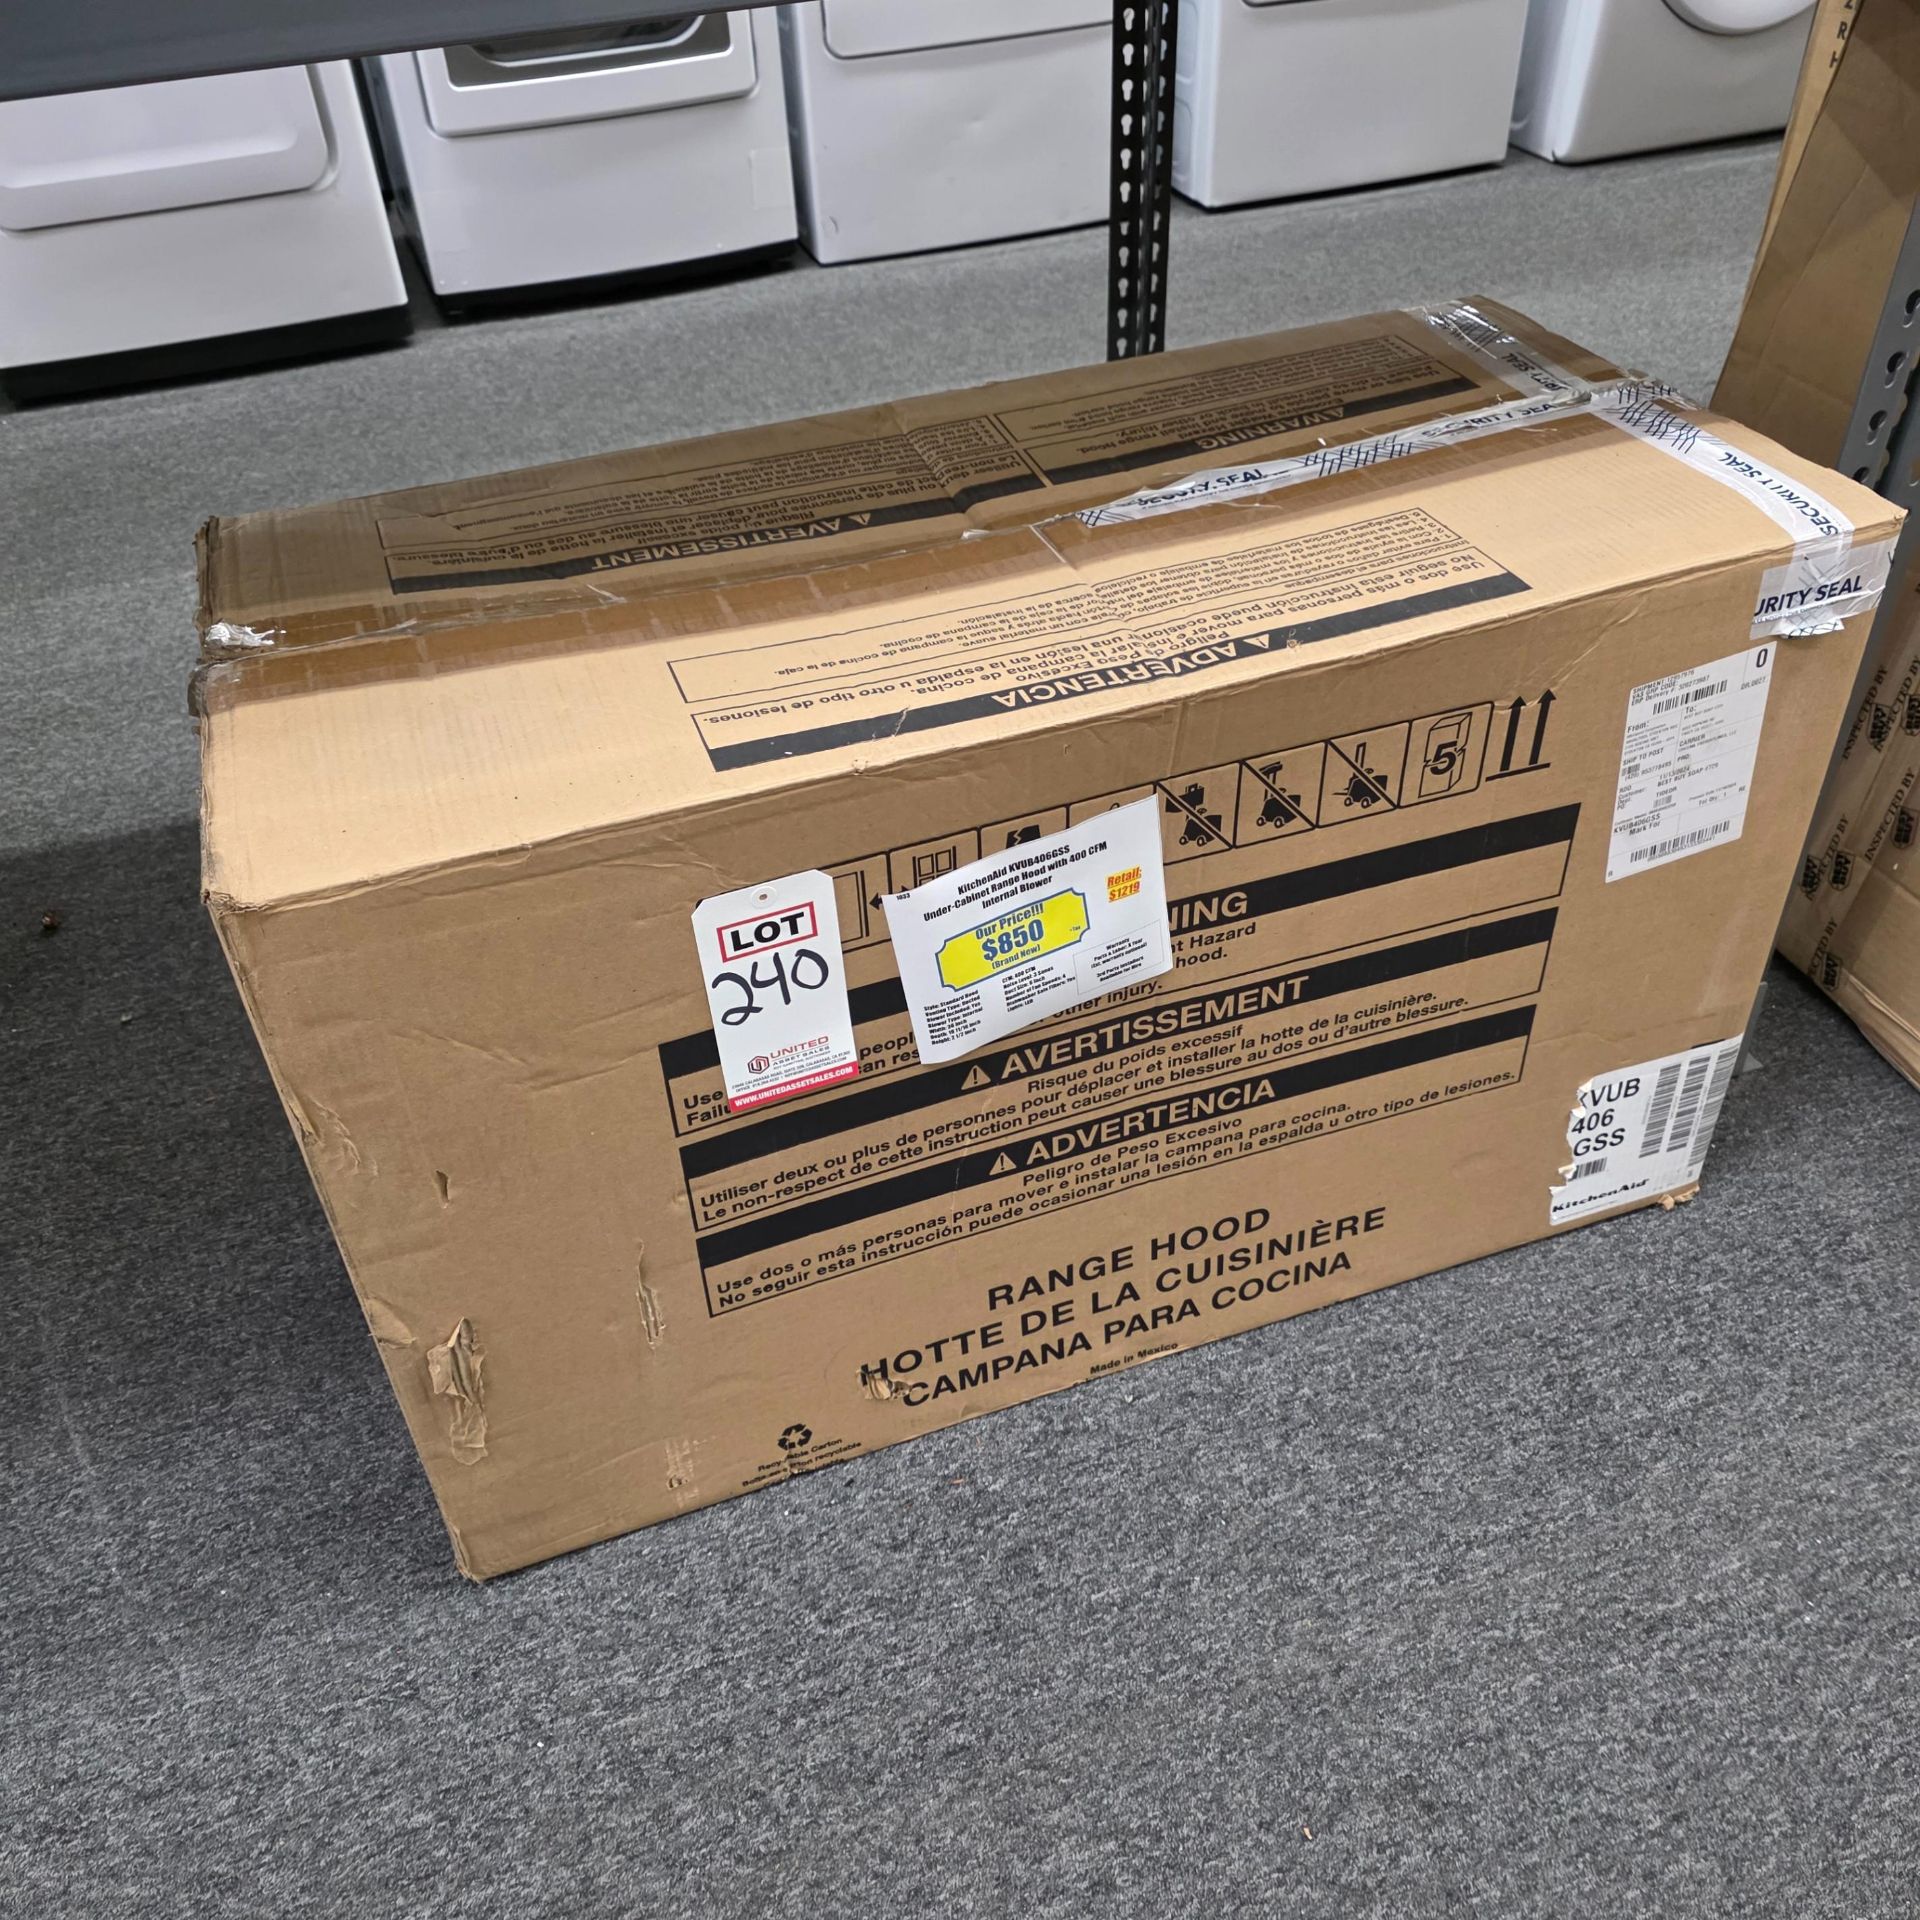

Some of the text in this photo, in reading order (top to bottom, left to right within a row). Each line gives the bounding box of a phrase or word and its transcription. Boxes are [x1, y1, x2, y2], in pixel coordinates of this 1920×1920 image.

[1195, 412, 1329, 450] WARNING
[1718, 452, 1762, 478] SEAL
[592, 518, 841, 572] AVERTISSEMENT
[1814, 575, 1862, 601] SEAL
[992, 644, 1238, 708] ADVERTENCIA
[1755, 647, 1769, 669] 0
[703, 636, 1122, 725] una lesión en la espalda u otro tipo de lesiones.
[1627, 720, 1650, 734] From:
[1429, 740, 1458, 777] 5
[923, 840, 1108, 922] Under-Cabinet Range Hood with 400 CFM
[957, 844, 1071, 896] KitchenAid KVUB406GSS
[1107, 867, 1142, 889] Retail:
[1109, 881, 1140, 902] $1219
[981, 875, 1053, 909] Internal Blower
[731, 911, 805, 952] LOT
[976, 902, 1045, 940] Our Price!!!
[981, 919, 1044, 962] $850
[1190, 921, 1256, 949] Hazard
[991, 943, 1041, 970] (Brand New)
[711, 948, 829, 1026] 240
[683, 1090, 724, 1109] Use
[859, 1031, 915, 1060] peopl
[1176, 947, 1228, 968] hood.
[892, 1049, 920, 1065] res
[1108, 981, 1162, 1003] injury.
[1001, 975, 1309, 1079] AVERTISSEMENT
[770, 1036, 829, 1060] UNITED
[773, 1053, 801, 1066] ASSET
[801, 1045, 830, 1058] SALES
[1027, 1024, 1243, 1094] Risque du poids excessif
[700, 992, 1437, 1208] Utiliser deux ou plus de personnes pour déplacer et installer la hotte de la cuisinière.
[734, 1065, 854, 1108] WWW.UNITEDASSETSALES.COM
[703, 1208, 727, 1223] Le
[731, 1168, 846, 1213] non-respect
[849, 1160, 873, 1176] de
[877, 1146, 923, 1167] cette
[924, 1110, 1026, 1152] instruction
[1027, 1102, 1067, 1126] peut
[1071, 1084, 1130, 1110] causer
[1133, 1075, 1165, 1091] une
[1170, 1056, 1242, 1082] blessure
[1247, 1049, 1268, 1063] au
[1272, 1039, 1303, 1055] dos
[1307, 1032, 1329, 1046] ou
[1395, 997, 1469, 1023] blessure.
[1026, 1078, 1276, 1166] ADVERTENCIA
[1571, 1107, 1615, 1135] 406
[1023, 1118, 1242, 1187] Peligro de Peso Excesivo
[1573, 1127, 1627, 1157] GSS
[716, 1103, 1351, 1294] Use dos o más personas para mover e instalar la campana para cocina.
[719, 1071, 1515, 1308] No seguir esta instrucción puede ocasionar una lesión en la espalda u otro tipo de lesiones.
[1552, 1178, 1649, 1213] KitchenAid
[988, 1208, 1270, 1311] RANGE HOOD
[860, 1206, 1386, 1389] HOTTE DE LA CUISINIÈRE
[903, 1251, 1351, 1407] CAMPANA PARA COCINA
[1089, 1342, 1179, 1375] Made in Mexico
[811, 1438, 843, 1453] Carton
